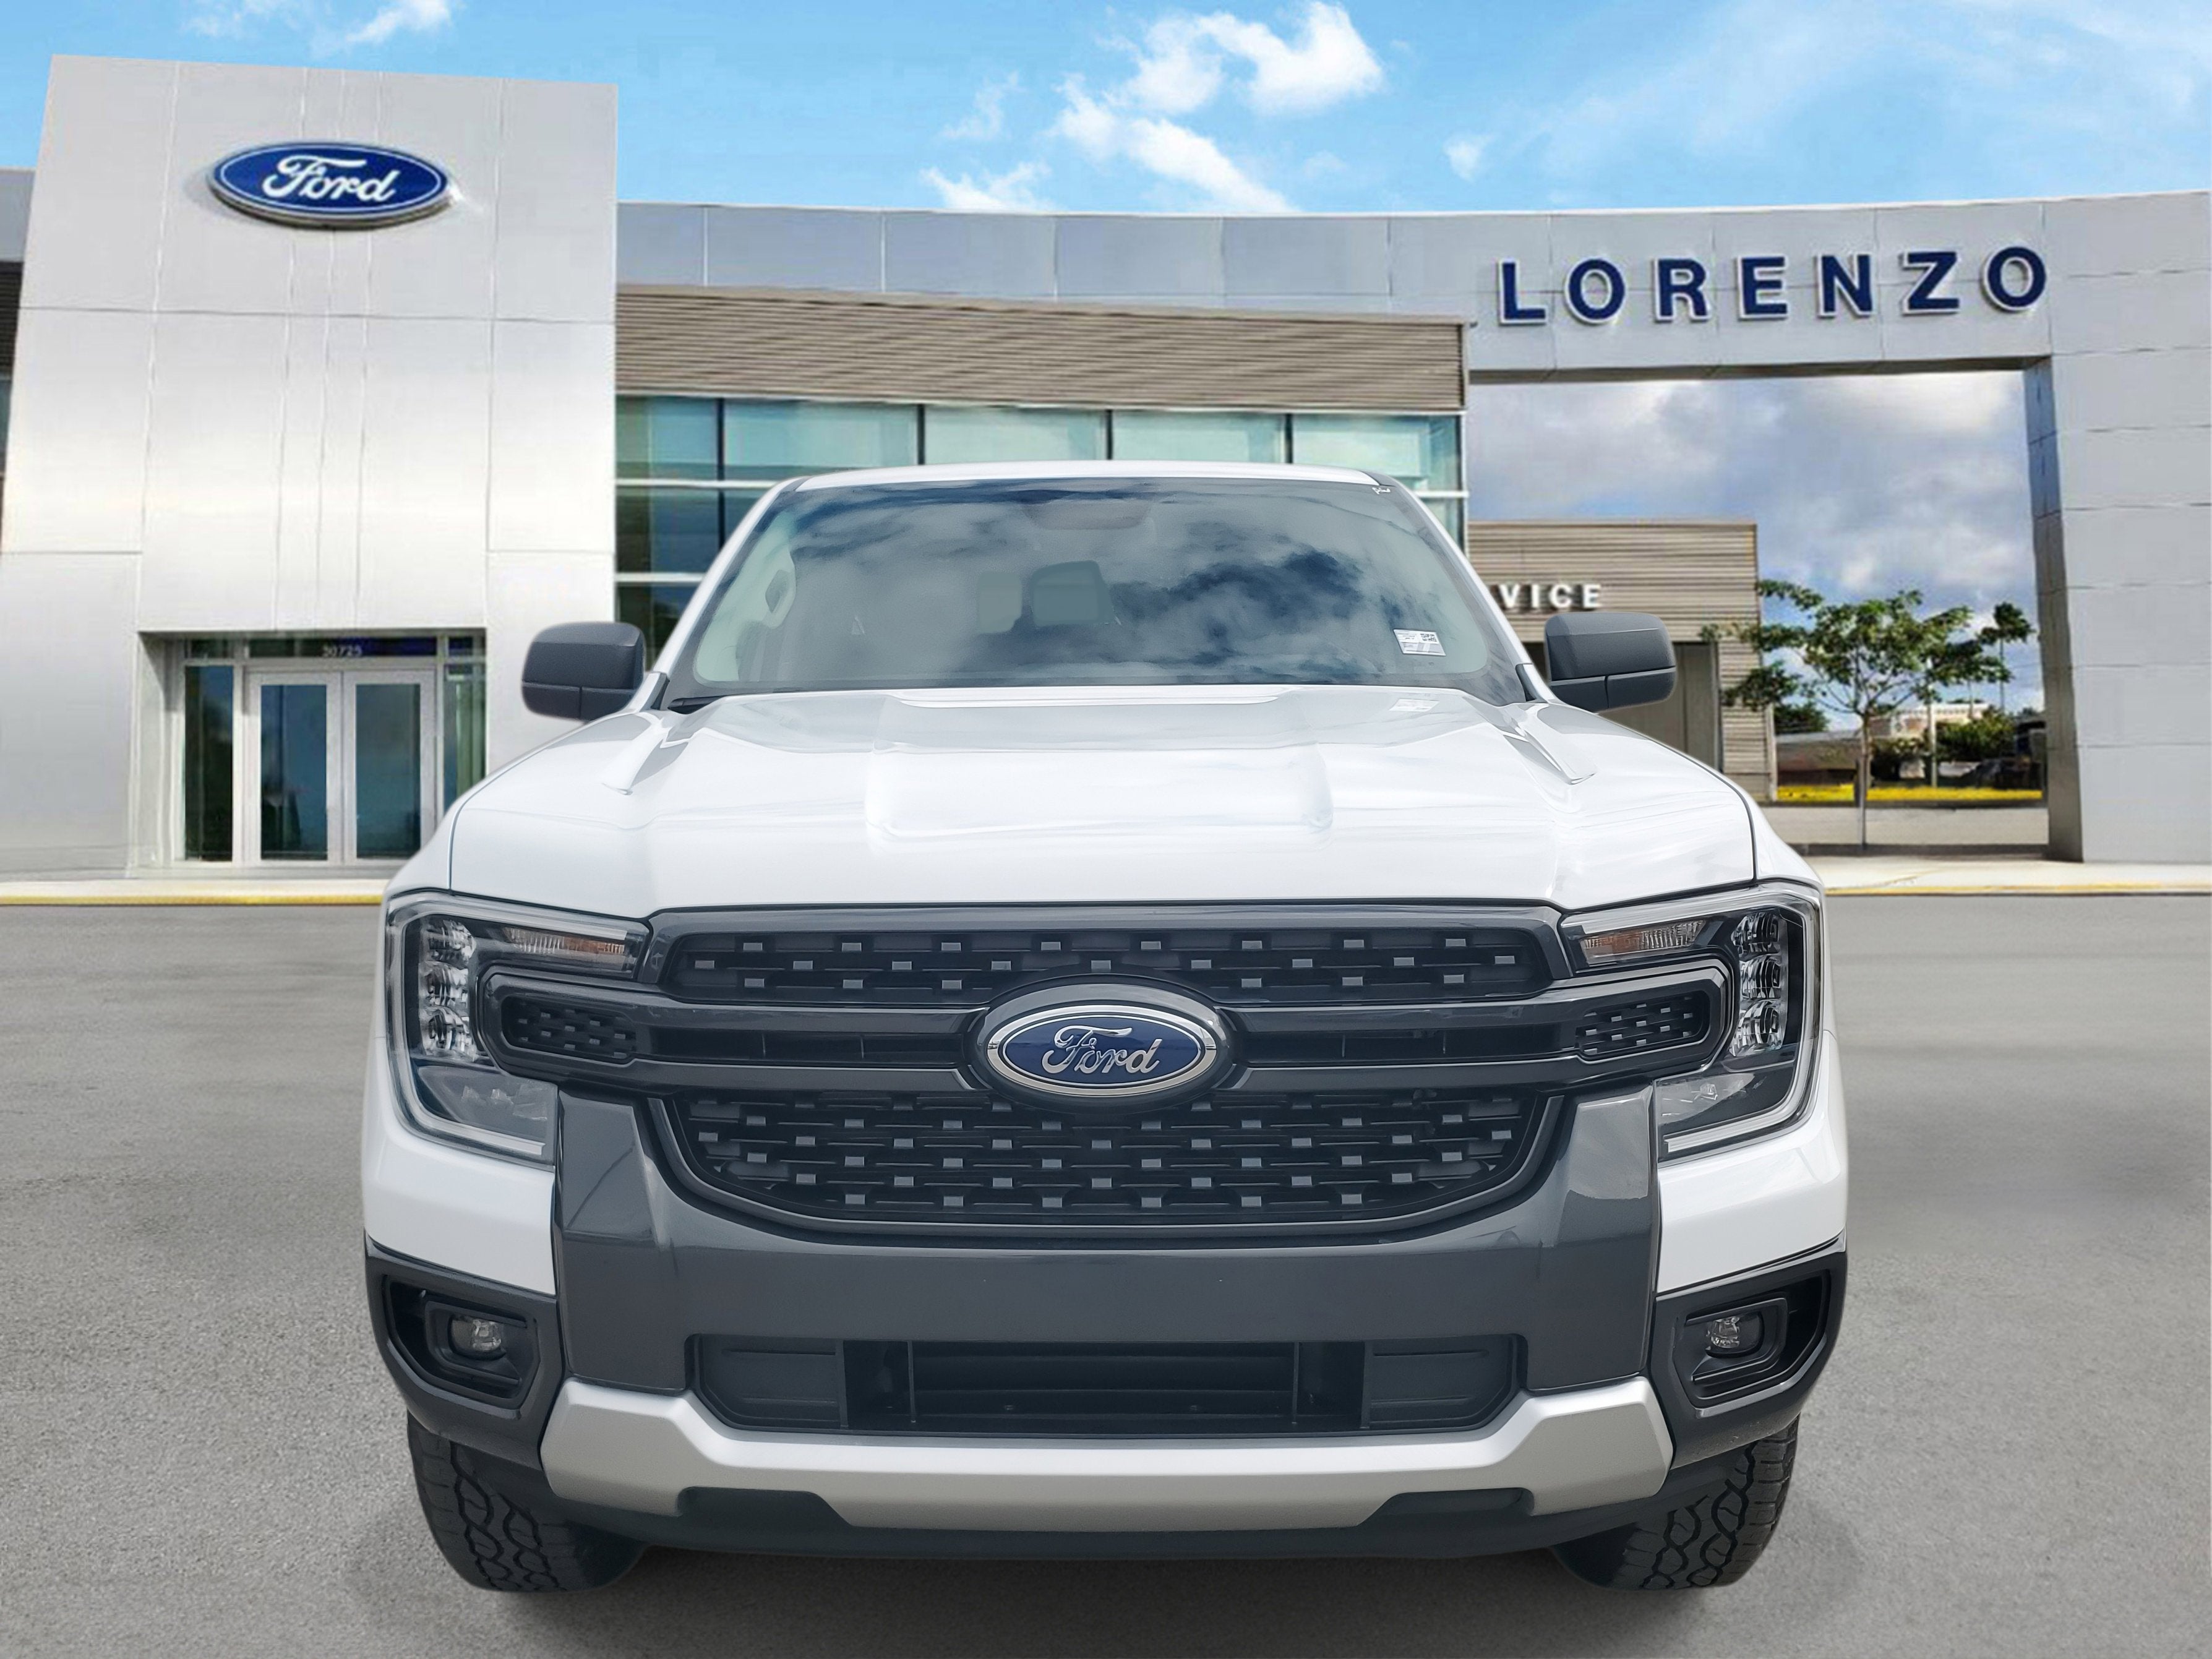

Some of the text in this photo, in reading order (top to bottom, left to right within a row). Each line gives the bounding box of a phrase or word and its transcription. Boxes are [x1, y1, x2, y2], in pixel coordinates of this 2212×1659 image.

[262, 155, 400, 202] Ford
[1498, 247, 2047, 326] LORENZO
[1499, 583, 1601, 608] VICE
[1042, 1025, 1162, 1074] Ford
